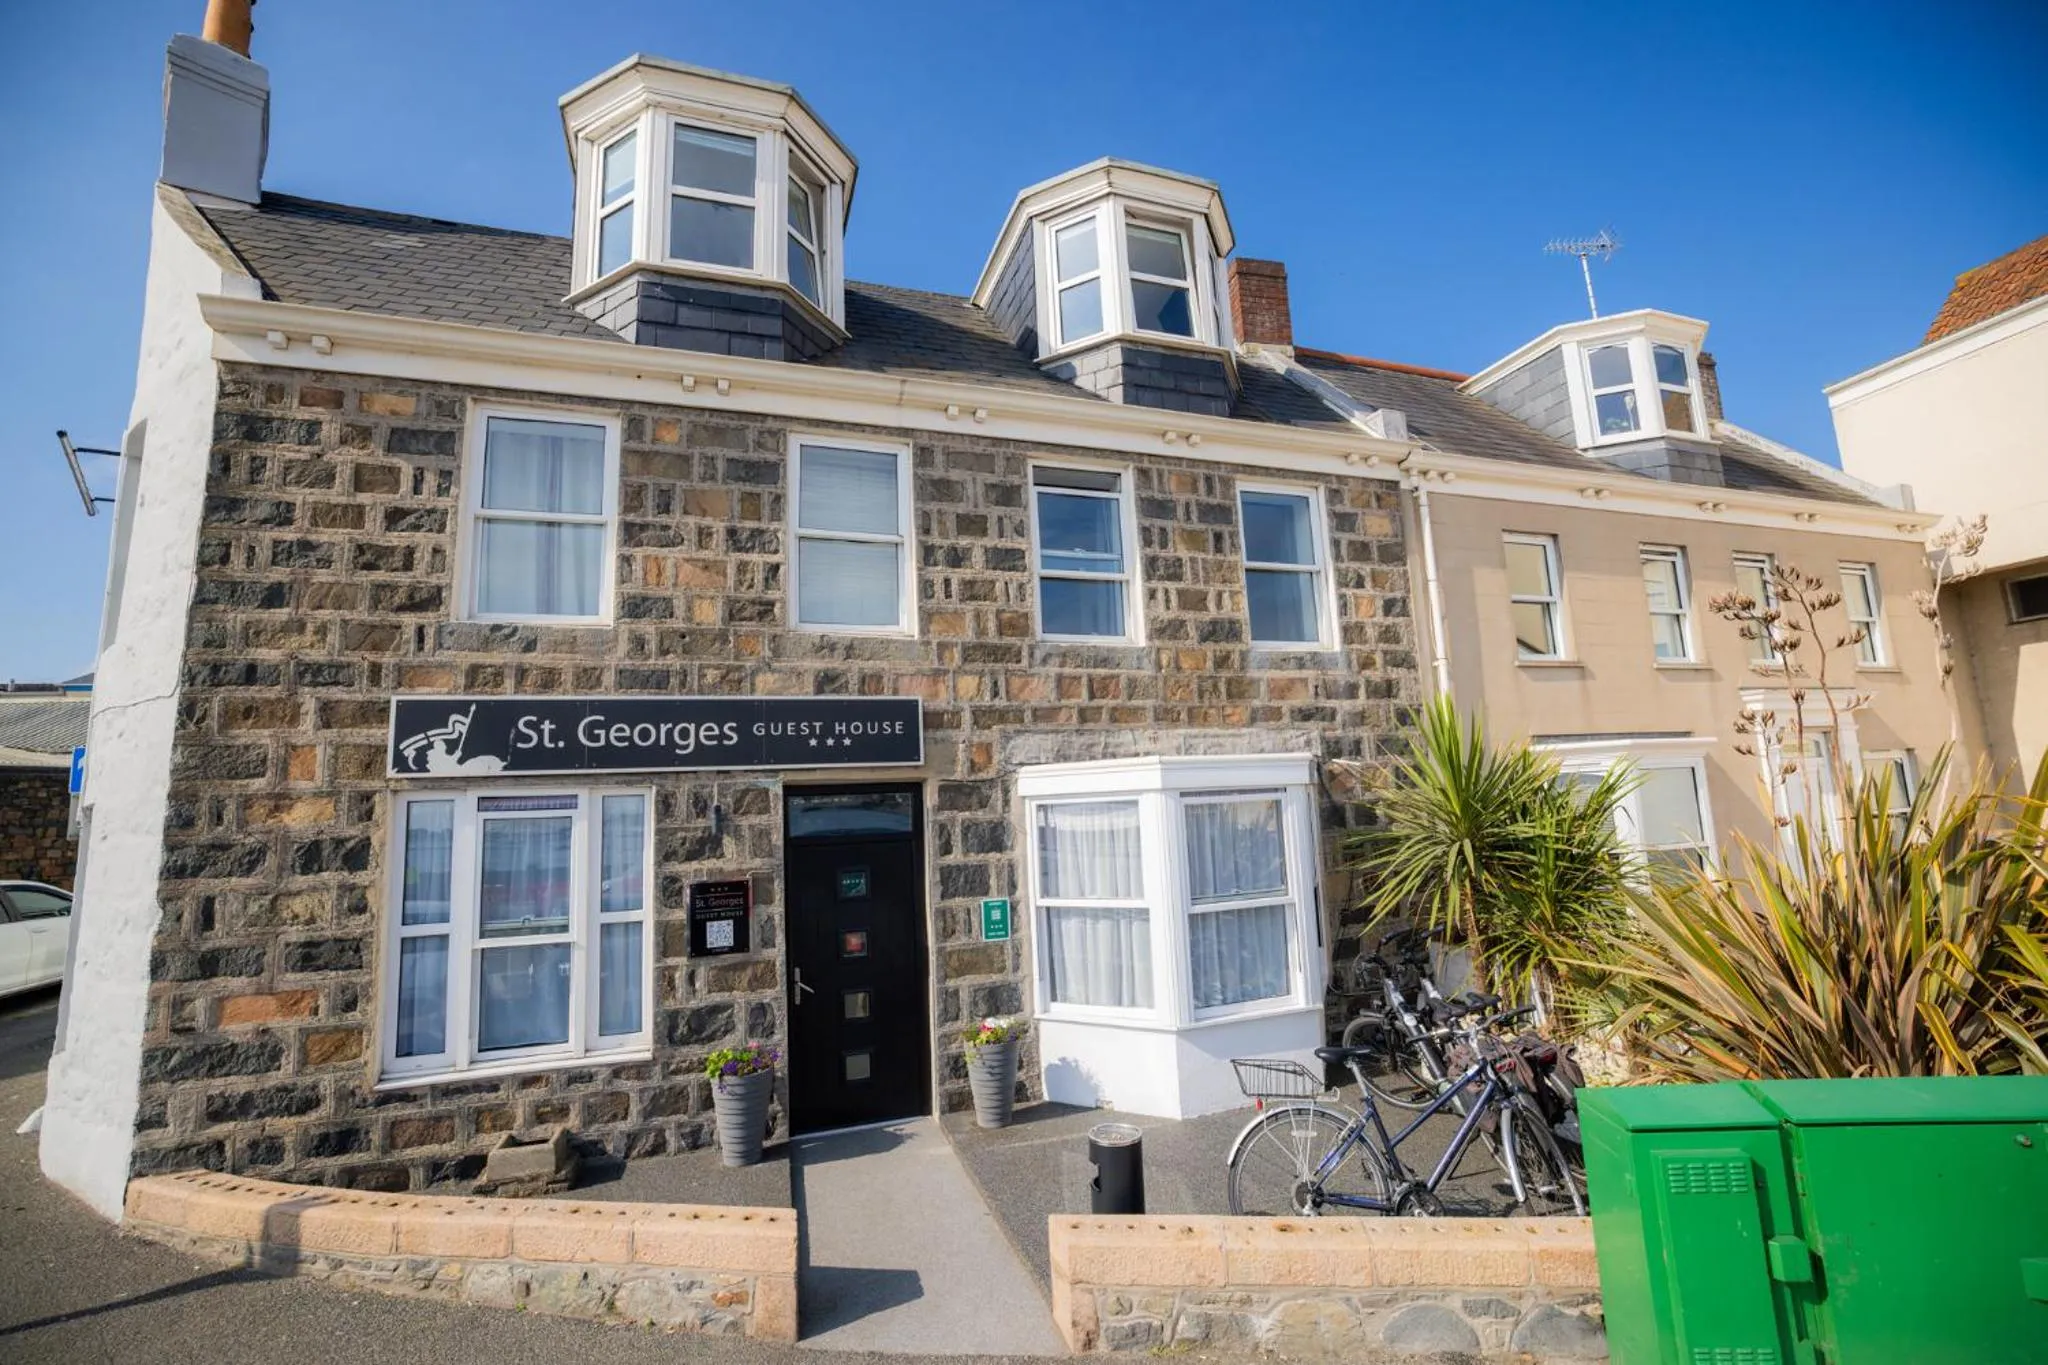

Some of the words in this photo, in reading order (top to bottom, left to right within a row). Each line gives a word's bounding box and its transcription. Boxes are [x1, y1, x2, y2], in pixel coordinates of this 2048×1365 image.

[516, 715, 565, 749] St.
[577, 715, 739, 755] Georges
[752, 721, 824, 736] GUEST
[834, 720, 905, 735] HOUSE
[708, 897, 744, 907] Georges
